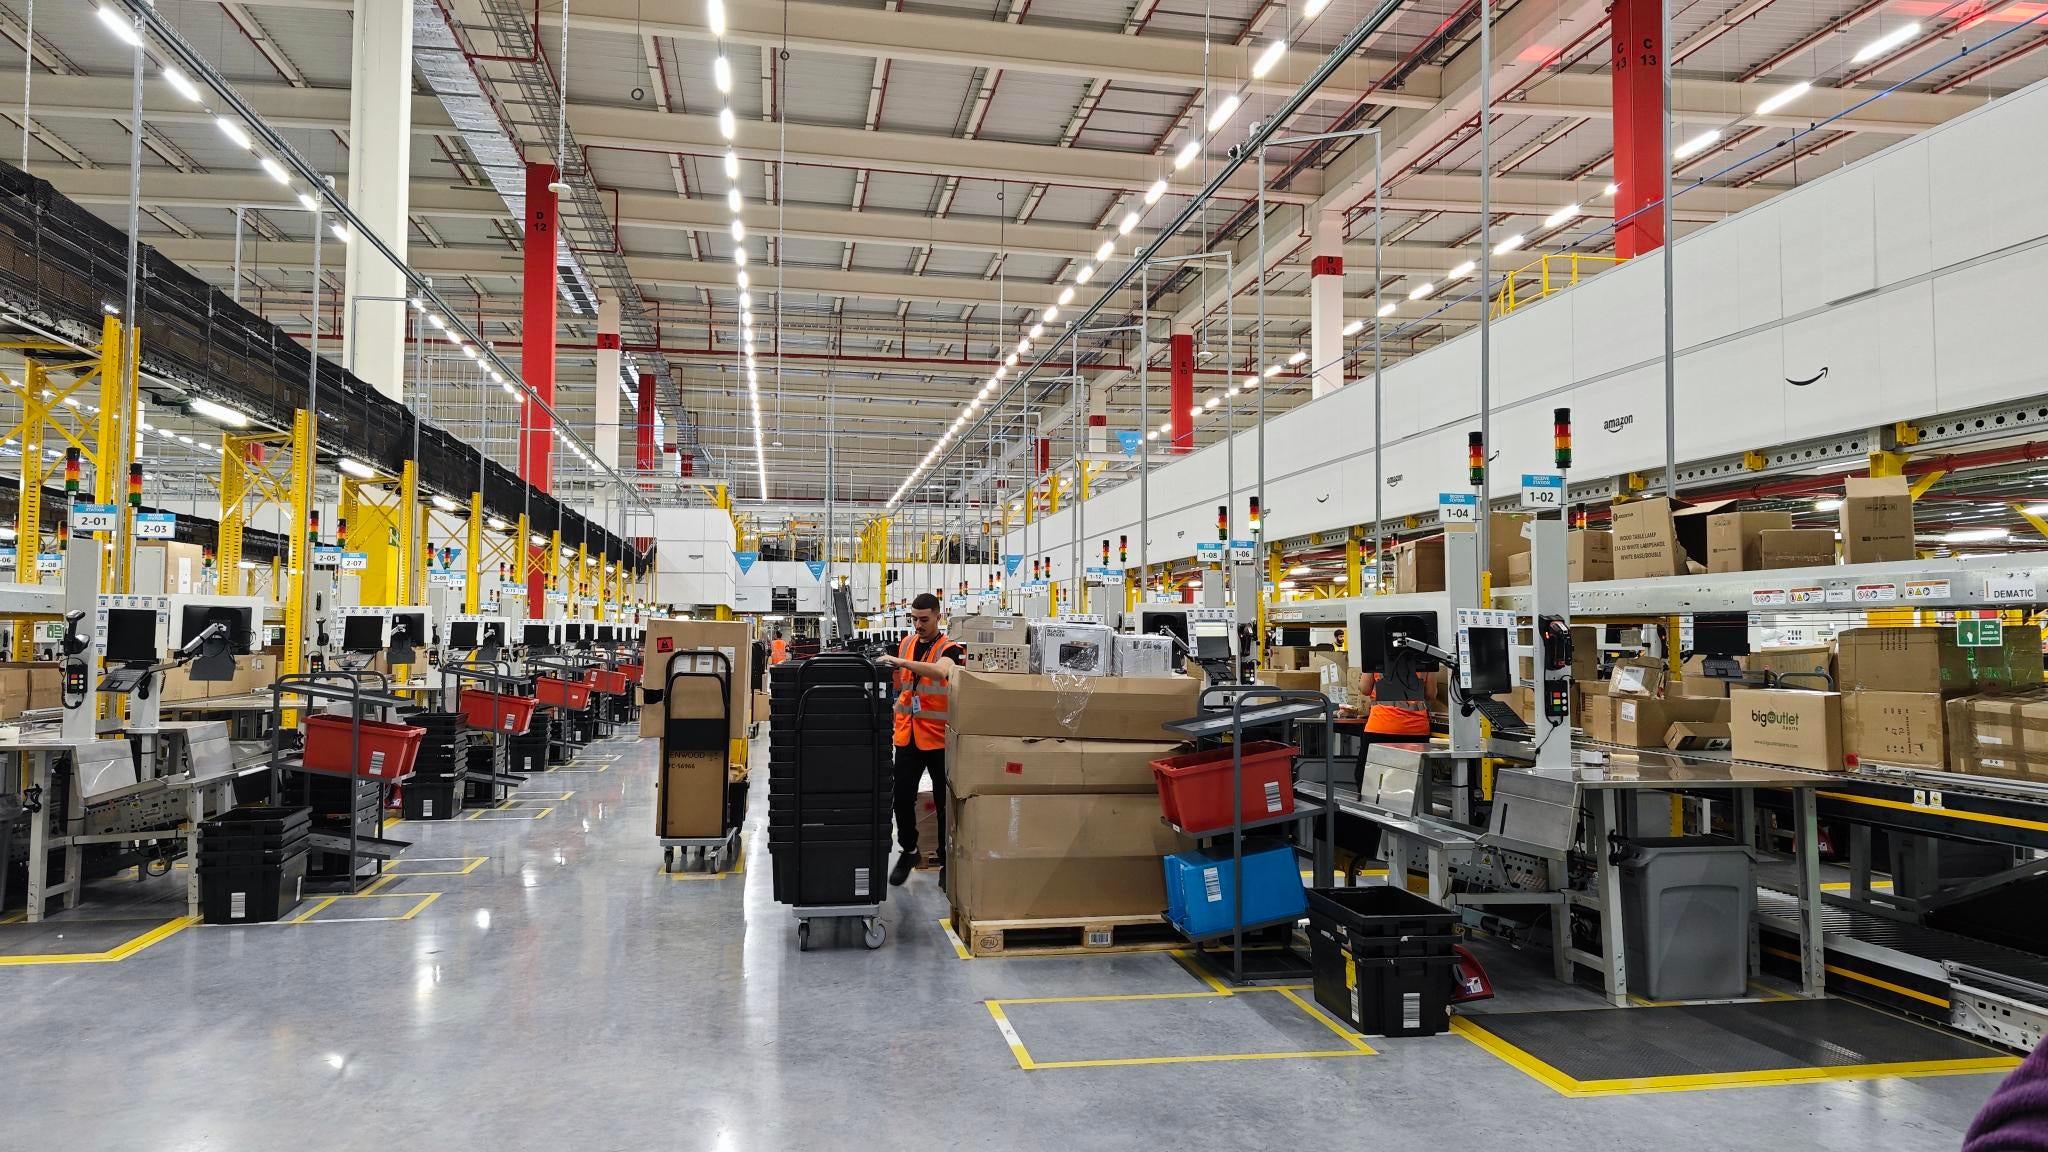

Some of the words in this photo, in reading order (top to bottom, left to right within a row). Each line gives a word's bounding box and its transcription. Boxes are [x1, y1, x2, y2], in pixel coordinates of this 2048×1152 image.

[1643, 38, 1652, 49] C
[1640, 54, 1656, 66] 13
[536, 211, 544, 220] D
[533, 223, 547, 232] 12
[1603, 414, 1634, 430] amazon
[1529, 491, 1554, 503] 1-02
[1446, 508, 1469, 518] 1-04
[81, 517, 107, 526] 2-01
[143, 525, 167, 533] 2-03
[319, 554, 336, 562] 2-05
[1235, 550, 1250, 558] 1-06
[1993, 589, 2034, 599] DEMATIC
[669, 751, 705, 759] ENWOOD
